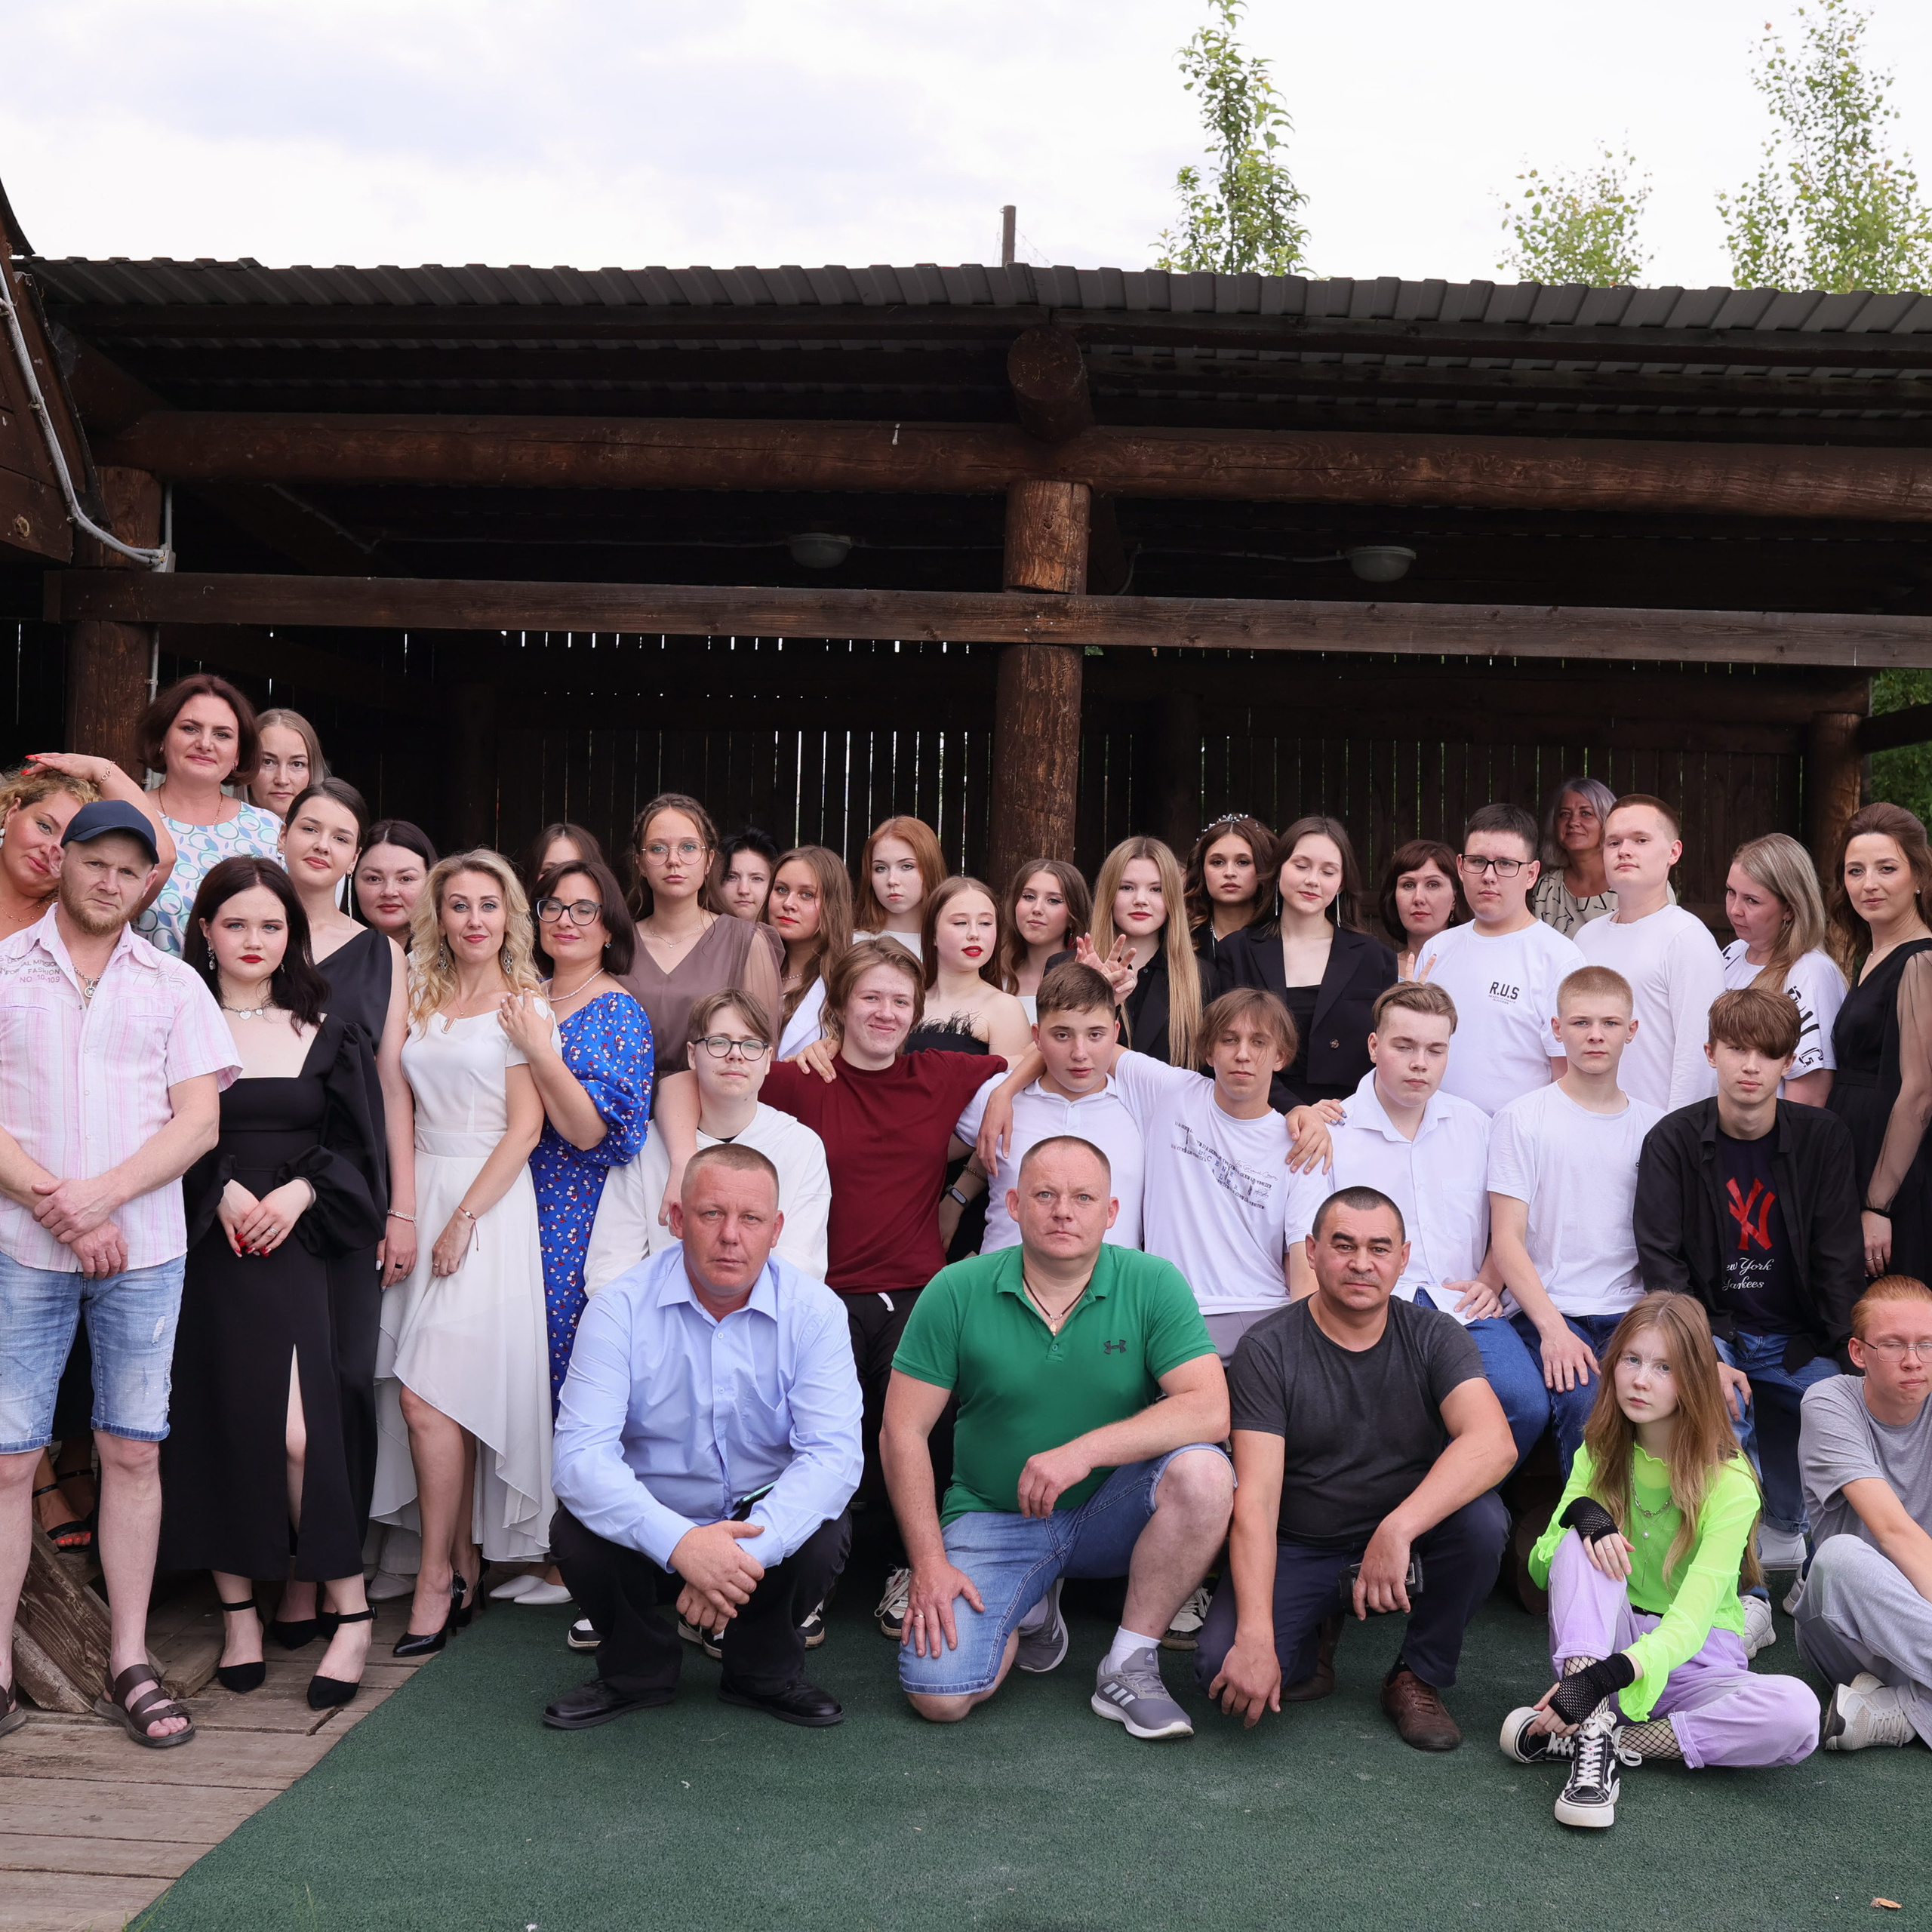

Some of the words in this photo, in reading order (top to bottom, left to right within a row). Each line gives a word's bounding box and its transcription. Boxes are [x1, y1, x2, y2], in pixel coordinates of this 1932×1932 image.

[28, 967, 60, 976] FASHION
[1489, 981, 1520, 1000] R.U.S
[1726, 1262, 1739, 1271] ew
[1739, 1257, 1775, 1275] York
